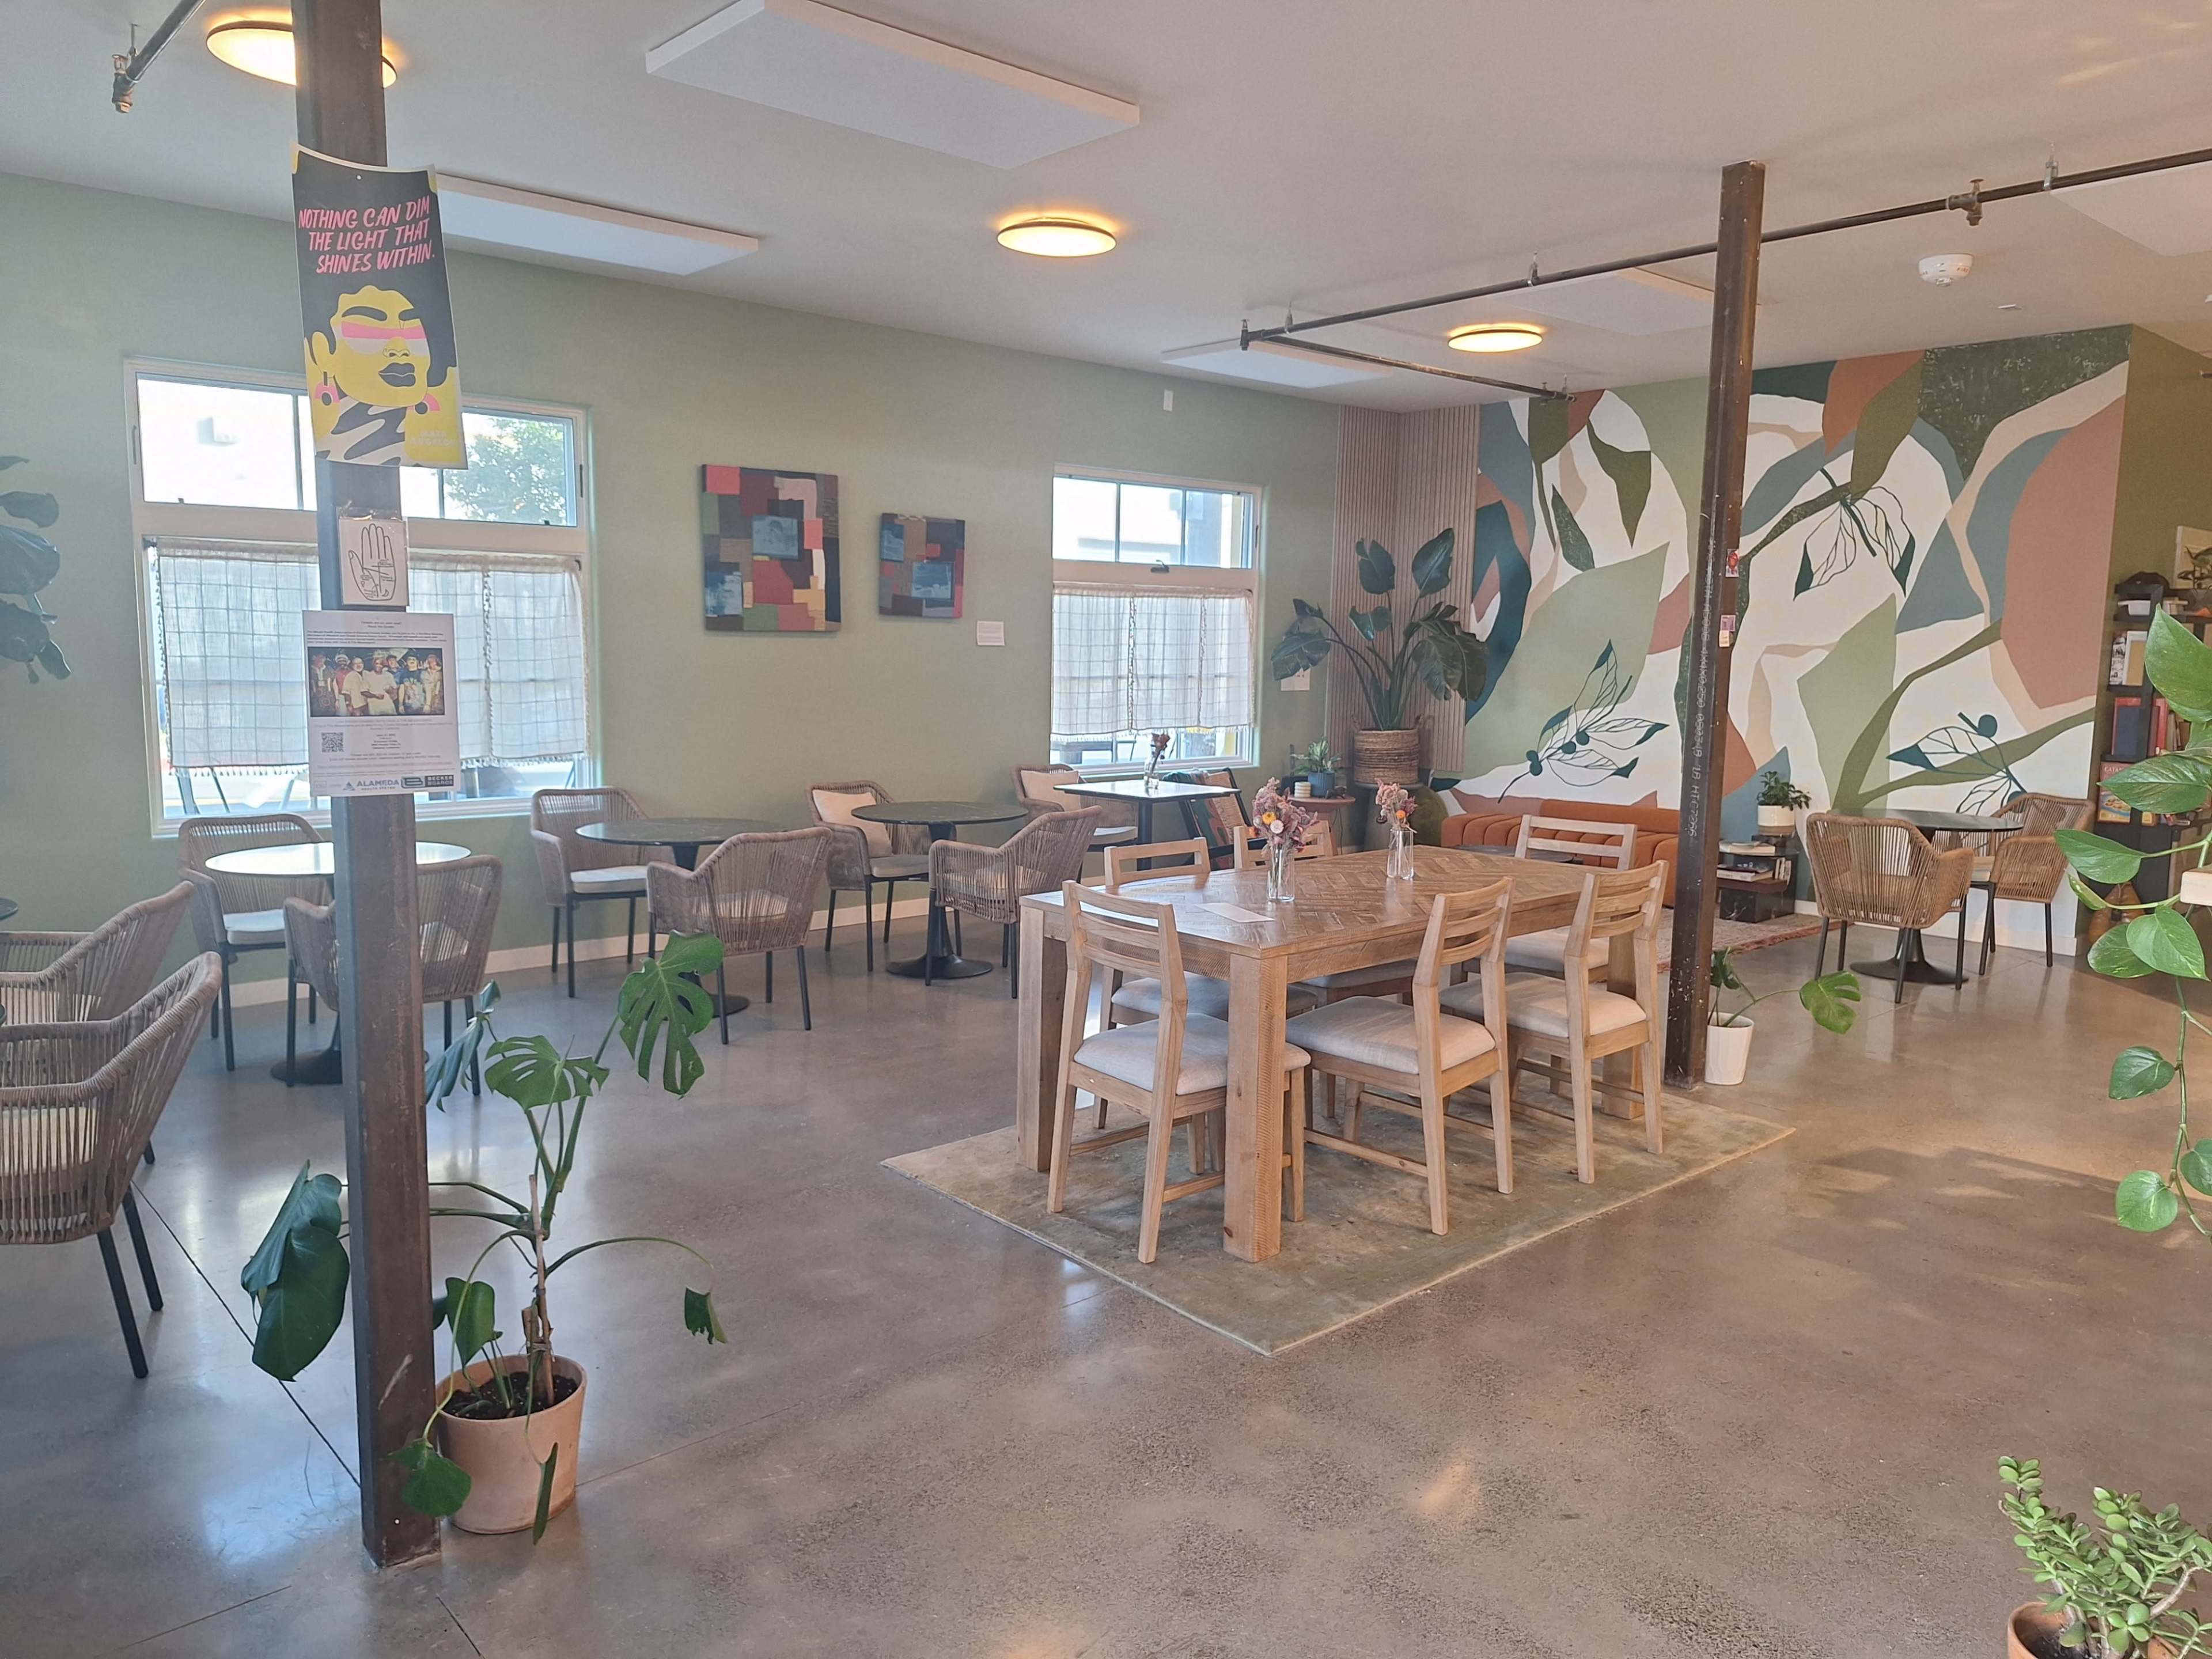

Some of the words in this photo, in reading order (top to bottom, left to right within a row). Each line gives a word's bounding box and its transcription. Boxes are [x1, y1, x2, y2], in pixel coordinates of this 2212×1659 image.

[298, 208, 358, 229] NOTHING
[363, 204, 401, 228] CAN
[406, 196, 430, 221] DIM
[309, 232, 334, 251] THE
[336, 229, 389, 251] LIGHT
[395, 218, 430, 245] THAT
[316, 253, 372, 274] SHINES
[377, 240, 435, 270] WITHIN.
